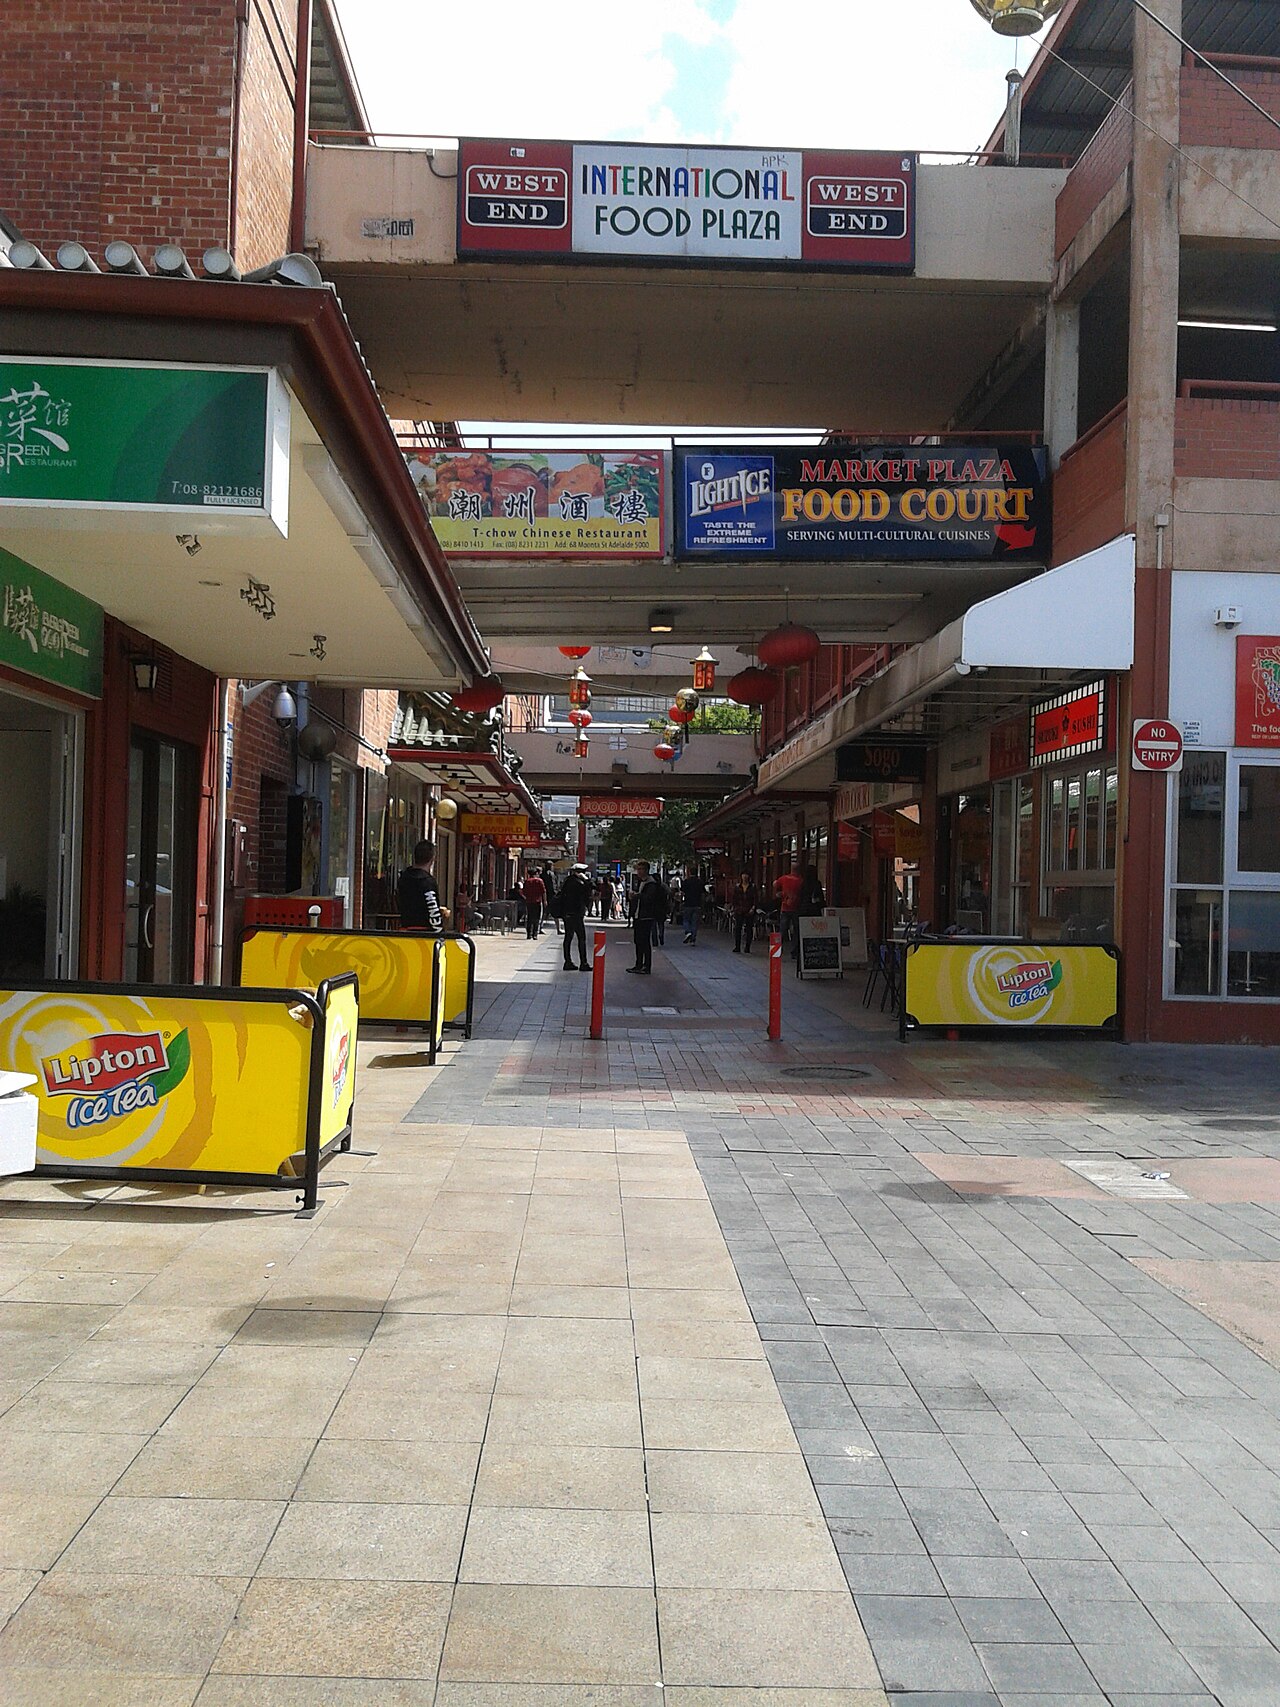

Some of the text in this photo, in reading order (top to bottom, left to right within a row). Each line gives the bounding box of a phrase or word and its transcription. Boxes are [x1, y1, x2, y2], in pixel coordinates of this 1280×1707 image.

[477, 173, 559, 193] WEST
[582, 164, 795, 201] INTERNATIONAL
[817, 184, 898, 202] WEST
[487, 202, 549, 221] END
[595, 205, 781, 240] FOOD PLAZA
[828, 213, 888, 231] END
[800, 459, 1017, 482] MARKET PLAZA
[781, 488, 890, 521] FOOD
[899, 488, 1034, 521] COURT
[473, 528, 648, 538] T-chow Chinese Restaurant
[787, 530, 990, 541] SERVING MULTI-CULTURAL CUISINES
[1151, 727, 1166, 738] NO
[1251, 724, 1267, 732] The
[1141, 751, 1175, 762] ENTRY
[583, 801, 658, 814] FOOD PLAZA
[424, 890, 443, 933] VENUM
[1000, 966, 1048, 988] Lipton
[1009, 983, 1048, 1007] Ice Tea
[49, 1044, 157, 1086] Lipton
[68, 1080, 157, 1127] Ice Tea
